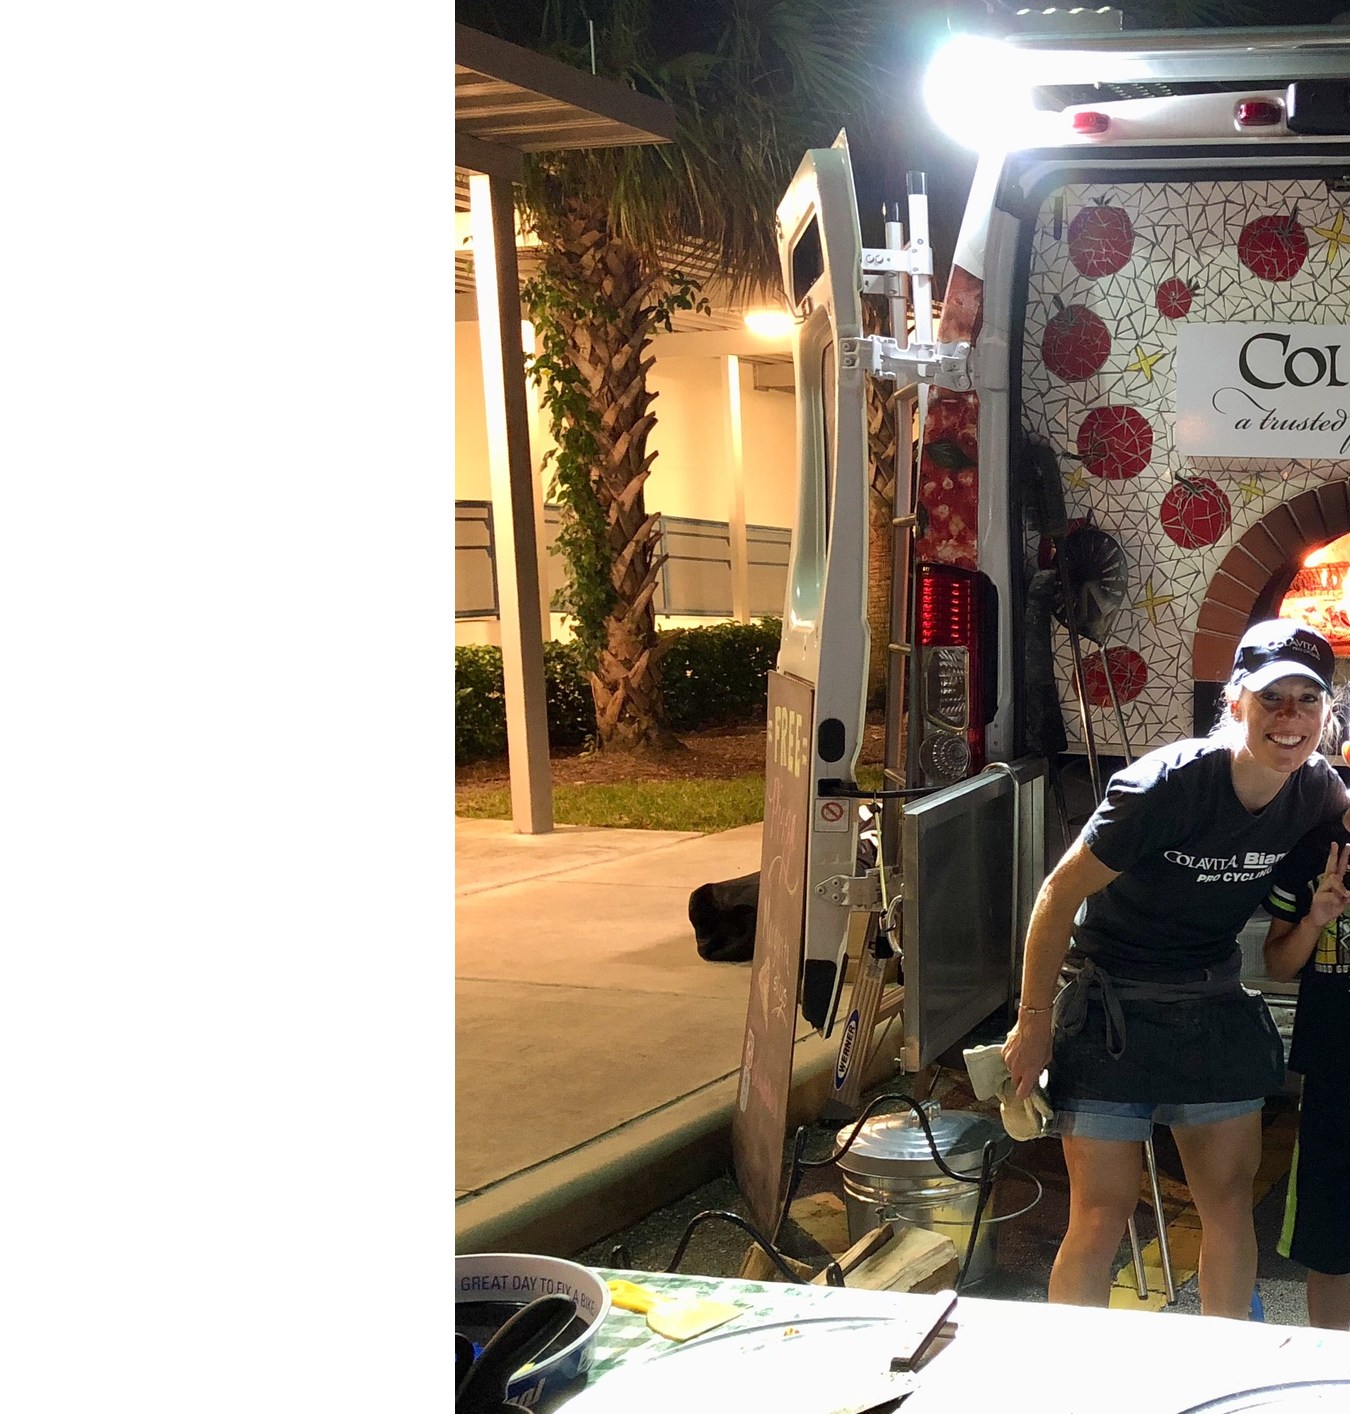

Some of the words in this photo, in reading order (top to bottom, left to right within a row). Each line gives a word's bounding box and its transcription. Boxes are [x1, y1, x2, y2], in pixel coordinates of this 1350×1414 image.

[1234, 416, 1253, 431] a
[1259, 407, 1348, 432] trusted
[774, 705, 803, 778] FREE
[1163, 850, 1239, 871] COLAVITA
[1196, 873, 1221, 883] PRO
[1222, 866, 1273, 882] CYCLING
[839, 1024, 855, 1073] WERNER
[461, 1275, 509, 1292] GREAT
[512, 1275, 538, 1293] DAY
[540, 1277, 554, 1294] TO
[556, 1281, 571, 1297] FIX
[573, 1289, 579, 1304] A
[581, 1292, 596, 1317] BIKE
